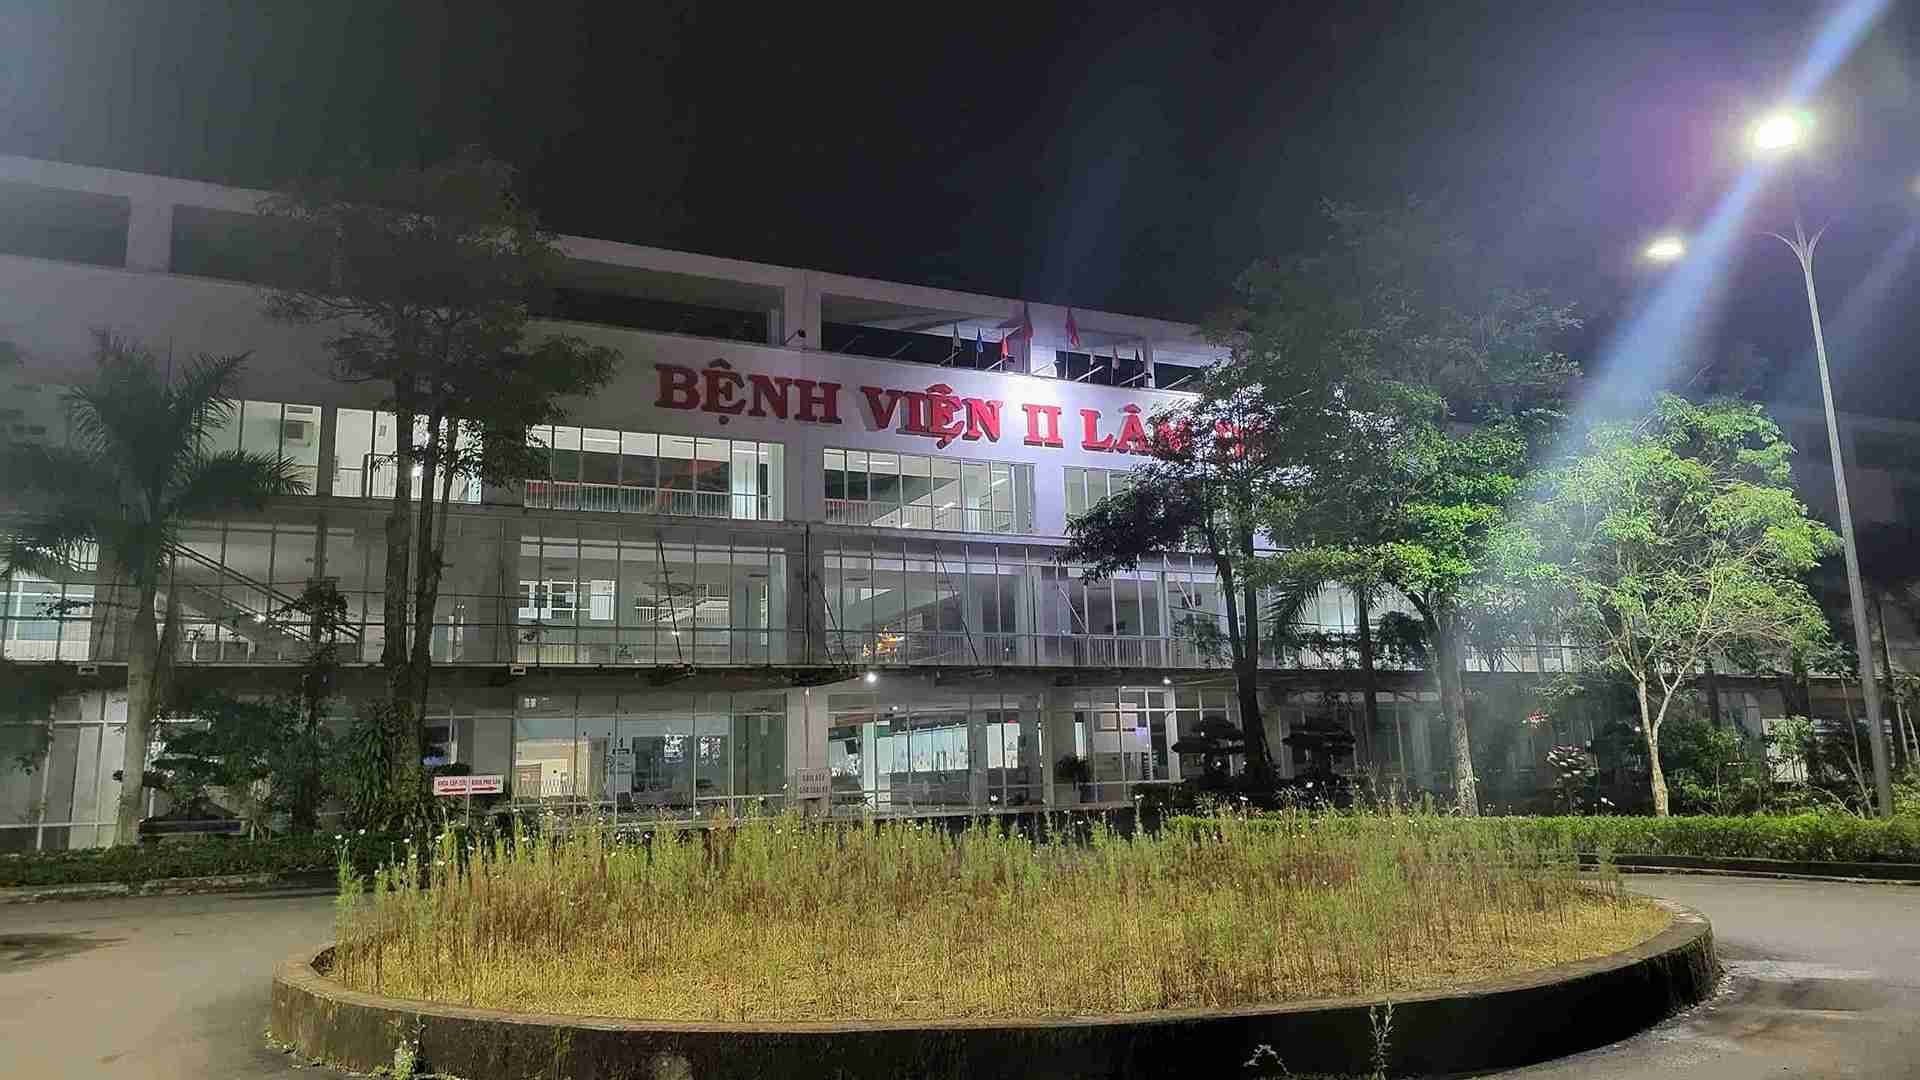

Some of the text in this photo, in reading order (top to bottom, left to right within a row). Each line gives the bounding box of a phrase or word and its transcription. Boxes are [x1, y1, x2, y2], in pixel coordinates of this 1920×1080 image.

[654, 358, 842, 425] BỆNH
[860, 383, 1003, 449] VIỆN
[1022, 403, 1064, 448] II
